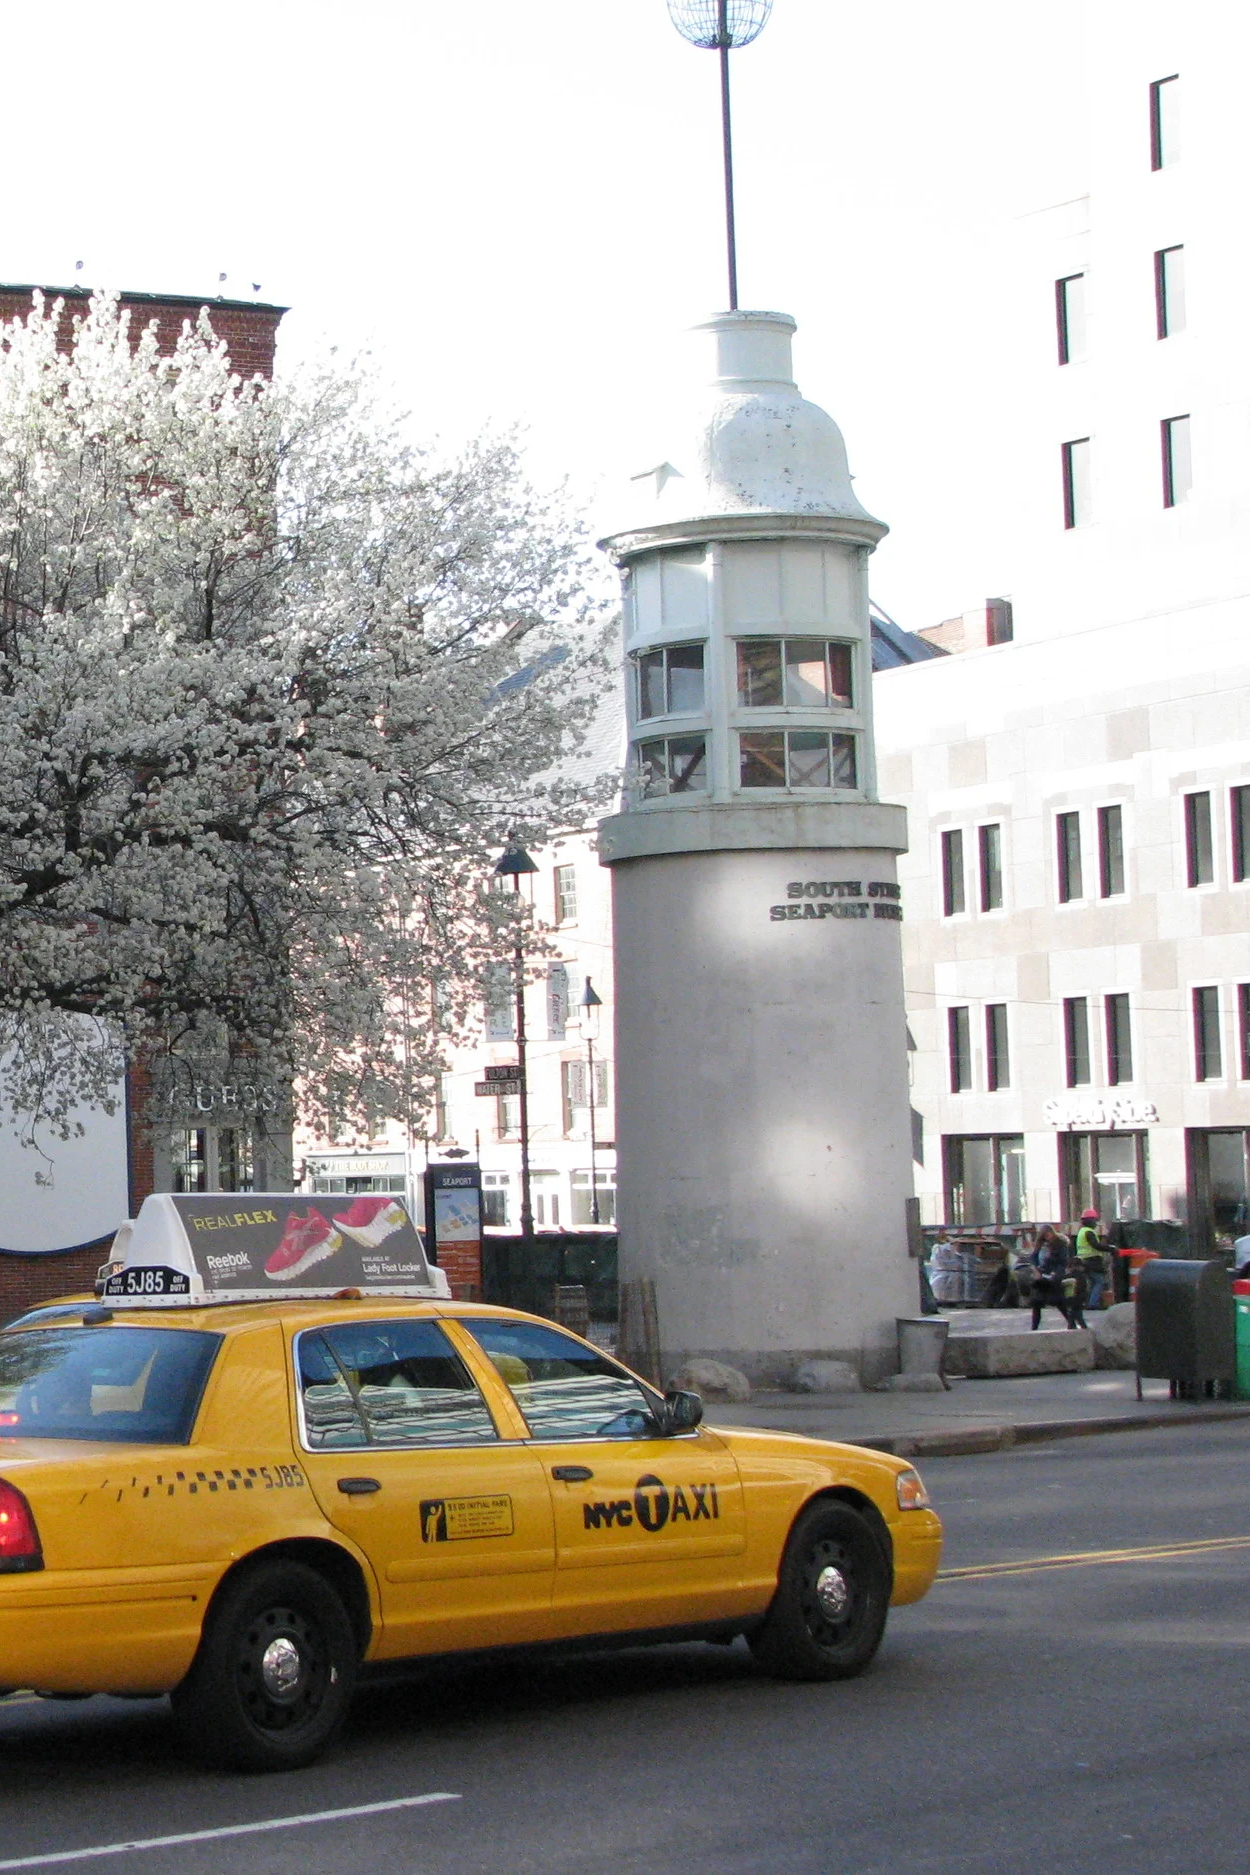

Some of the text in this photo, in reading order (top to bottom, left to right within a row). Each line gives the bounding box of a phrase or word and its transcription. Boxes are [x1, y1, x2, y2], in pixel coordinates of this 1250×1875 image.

[786, 881, 863, 899] SOUTH
[769, 902, 869, 921] SEAPORT
[476, 1083, 501, 1095] WATER
[442, 1177, 472, 1186] SEAPORT
[193, 1210, 277, 1231] REALFLEX
[206, 1251, 251, 1269] Reebok
[362, 1262, 421, 1274] Lady Foot Locker
[111, 1277, 123, 1285] OFF
[127, 1271, 164, 1294] 5J85
[172, 1275, 184, 1284] OFF
[109, 1285, 125, 1294] DUTY
[170, 1284, 186, 1293] DUTY
[260, 1464, 305, 1489] 5J85
[583, 1475, 719, 1530] NYC TAXI
